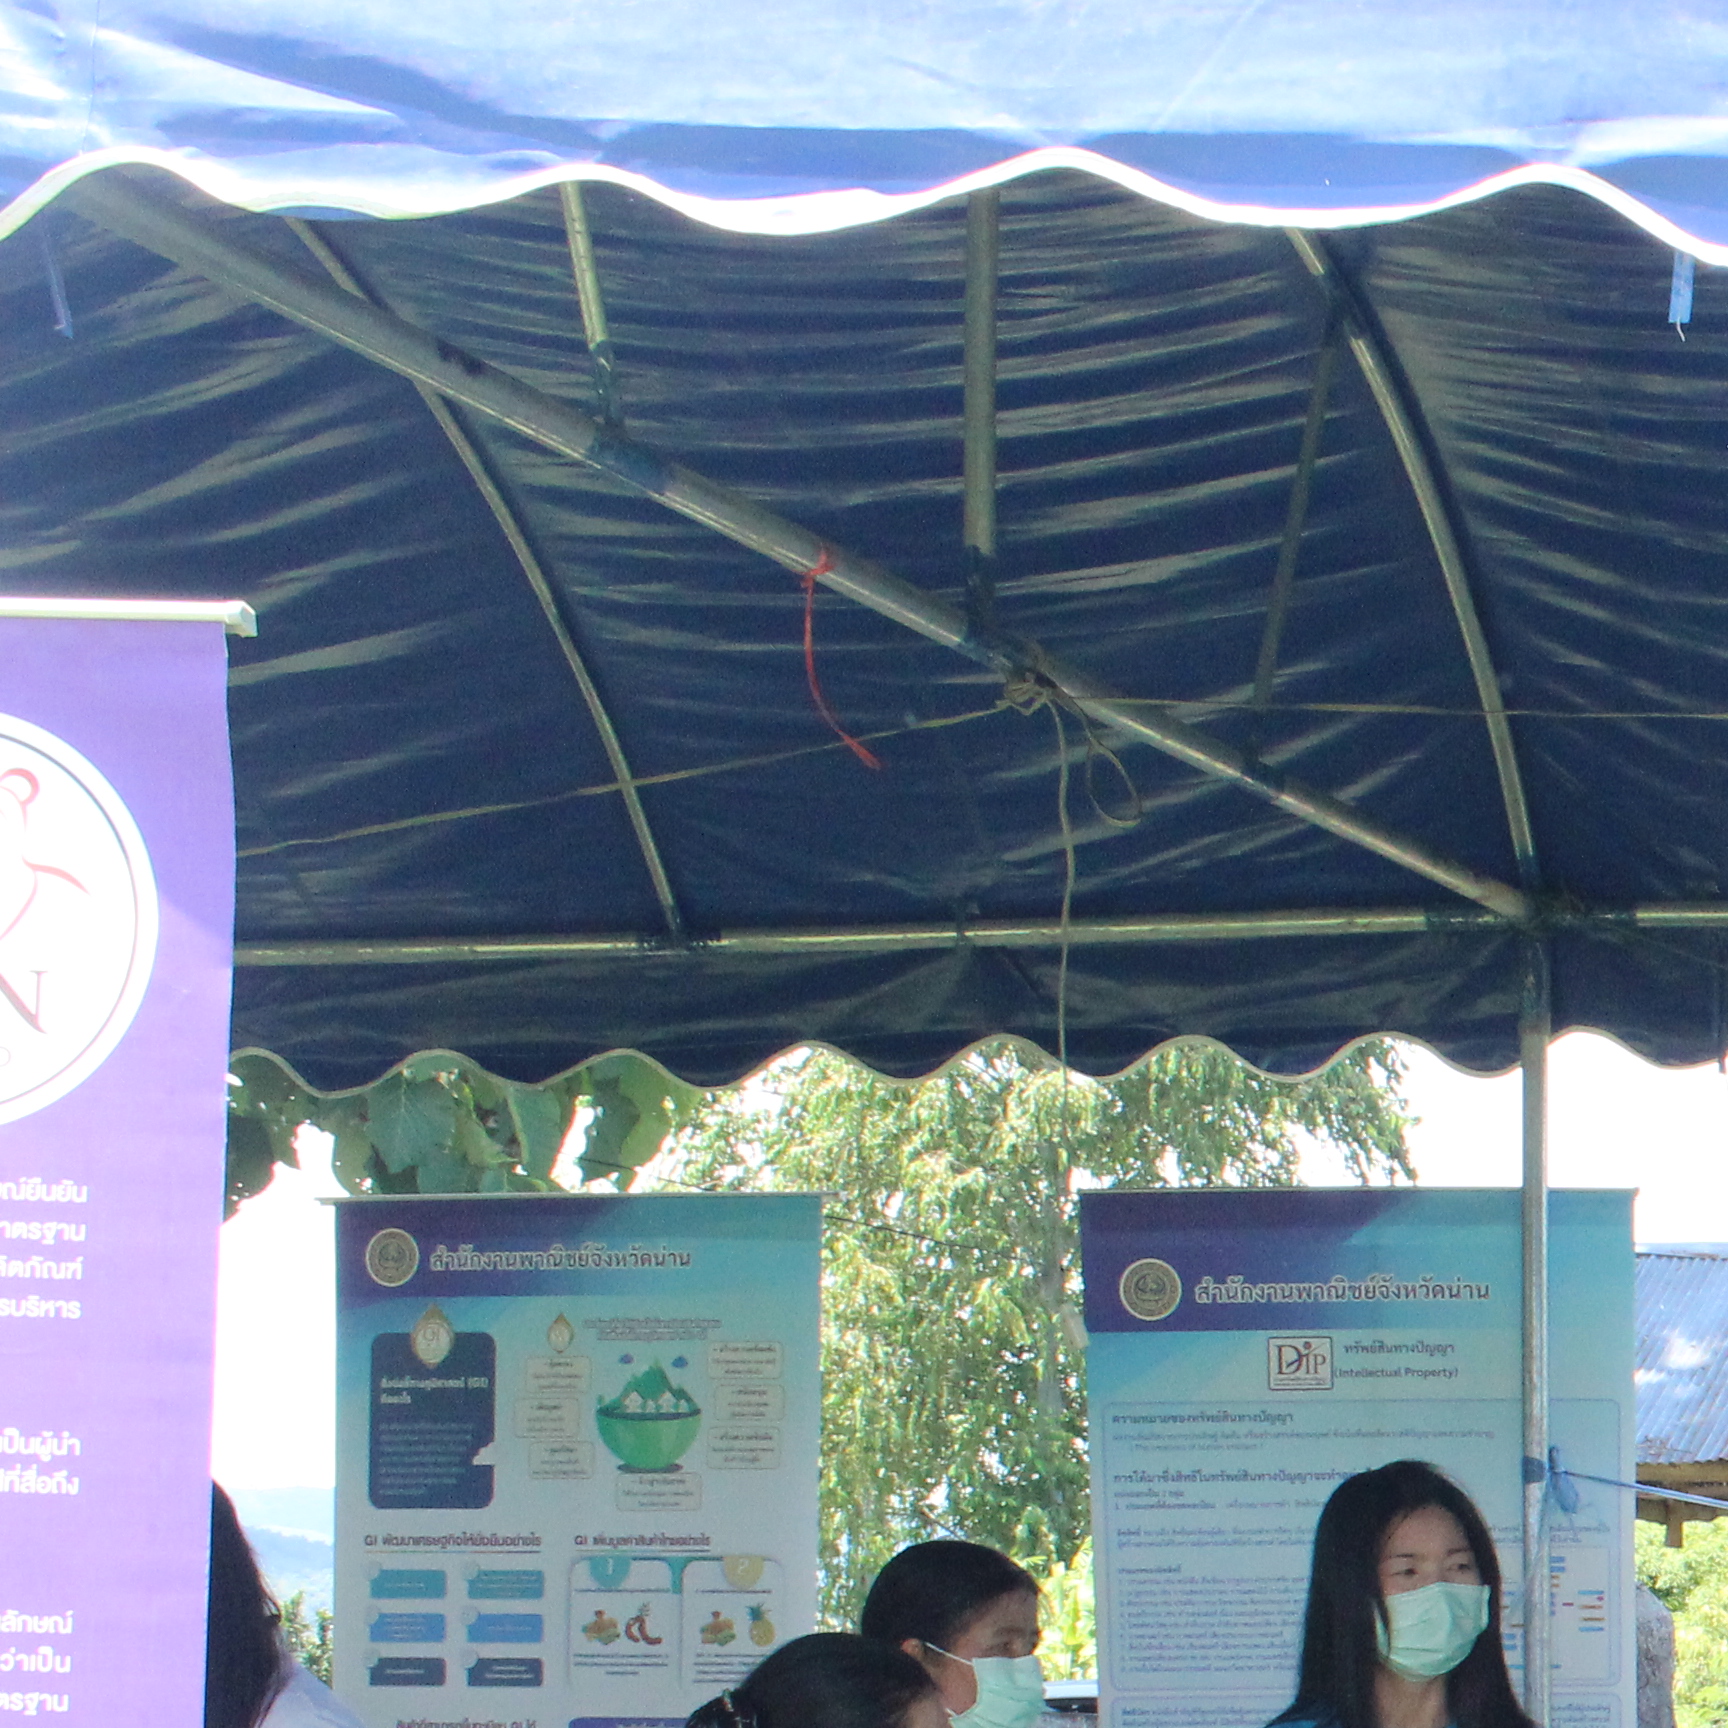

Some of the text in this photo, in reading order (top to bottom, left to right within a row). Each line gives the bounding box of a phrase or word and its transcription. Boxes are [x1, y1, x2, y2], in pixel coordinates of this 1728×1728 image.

[430, 1243, 692, 1271] สำนักงานพาณิชย์จังหวัดน่าน
[1194, 1274, 1491, 1304] สำนักงานพาณิชย์จังหวัดน่าน
[1343, 1339, 1456, 1358] ทรัพย์สินทางปัญญา
[1404, 1366, 1459, 1381] Property)
